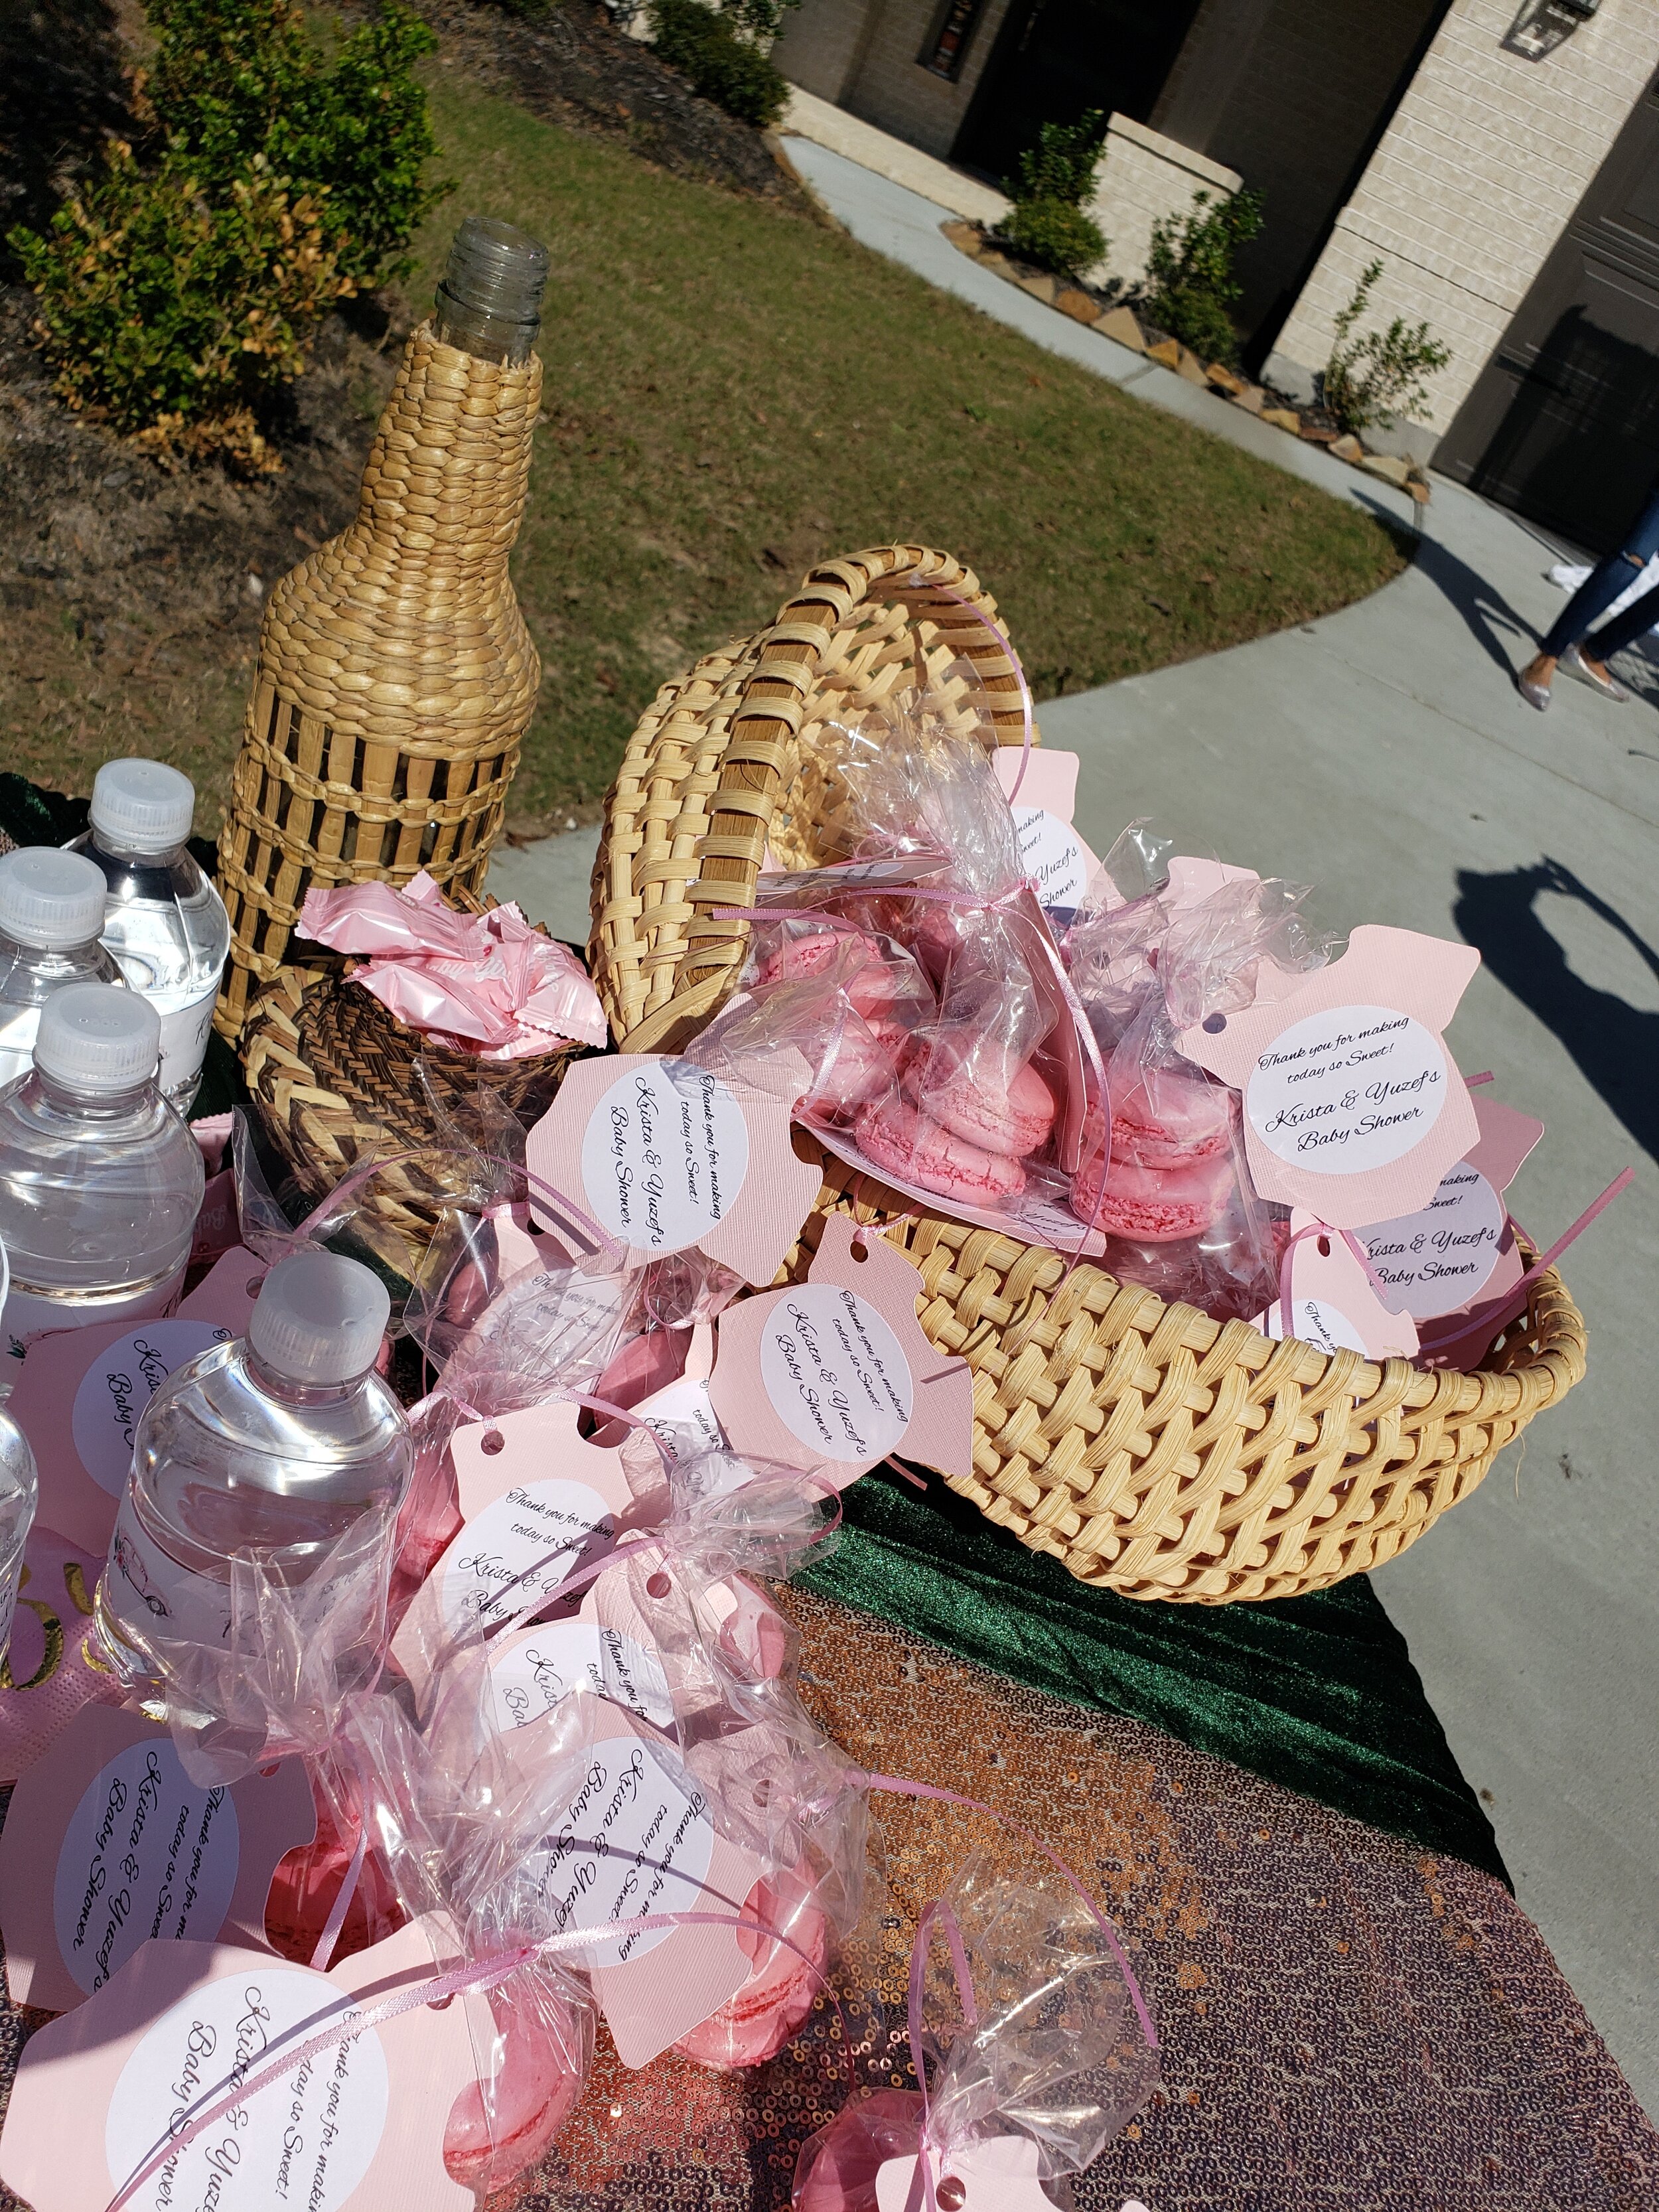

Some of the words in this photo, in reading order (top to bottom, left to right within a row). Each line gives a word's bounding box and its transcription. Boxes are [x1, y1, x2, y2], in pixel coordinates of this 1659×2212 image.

[1035, 846, 1078, 885] Yuzef's
[1039, 879, 1077, 909] Shower
[472, 957, 508, 982] Gir
[1258, 1048, 1307, 1070] Thank
[1309, 1042, 1333, 1057] you
[1332, 1034, 1356, 1051] for
[1358, 1017, 1409, 1039] making
[1287, 1067, 1325, 1083] today
[1329, 1061, 1342, 1071] so
[1346, 1043, 1394, 1066] Sweet!
[635, 1076, 659, 1147] Krista
[680, 1101, 693, 1138] today
[699, 1075, 715, 1122] Thank
[1265, 1103, 1336, 1132] Krista
[1340, 1090, 1359, 1109] &
[1365, 1070, 1441, 1105] Yuzef's
[611, 1106, 628, 1157] Baby
[684, 1140, 693, 1154] so
[702, 1124, 714, 1147] you
[1298, 1128, 1349, 1151] Baby
[1354, 1106, 1423, 1135] Shower
[642, 1149, 662, 1168] &
[684, 1157, 699, 1205] Sweet!
[704, 1145, 719, 1169] for
[615, 1161, 633, 1228] Shower
[642, 1174, 664, 1246] Yuzef's
[710, 1170, 721, 1219] making
[1410, 1234, 1430, 1253] &
[1431, 1228, 1497, 1253] Yuzef's
[1418, 1262, 1479, 1282] Shower
[1305, 1301, 1331, 1341] Thank
[1327, 1343, 1337, 1353] yo
[133, 1339, 169, 1396] Kris
[787, 1303, 822, 1366] Krista
[820, 1368, 835, 1386] &
[828, 1390, 867, 1456] Yuzef's
[832, 1318, 852, 1353] today
[850, 1355, 859, 1367] so
[857, 1368, 884, 1412] Sweet!
[839, 1291, 867, 1333] Thank
[861, 1333, 875, 1356] you
[871, 1356, 883, 1376] for
[882, 1378, 908, 1422] making
[107, 1373, 133, 1433] Baby
[776, 1334, 802, 1380] Baby
[799, 1384, 832, 1445] Shower
[692, 1409, 711, 1434] today
[506, 1488, 544, 1514] Thank
[545, 1509, 564, 1523] you
[563, 1513, 580, 1526] for
[580, 1520, 614, 1540] making
[510, 1522, 543, 1544] today
[543, 1534, 554, 1545] so
[555, 1536, 594, 1556] Sweet!
[459, 1553, 519, 1585] Krista
[522, 1572, 541, 1591] &
[526, 1649, 563, 1708] Kris
[601, 1629, 625, 1676] Thank
[618, 1674, 638, 1704] you
[96, 1777, 127, 1851] Baby
[129, 1751, 162, 1848] Krista
[569, 1761, 607, 1822] Baby
[603, 1749, 644, 1828] Krista
[169, 1805, 190, 1858] today
[198, 1786, 225, 1845] Thank
[642, 1804, 668, 1849] today
[674, 1791, 706, 1845] Thank
[119, 1853, 139, 1883] &
[190, 1846, 203, 1882] you
[590, 1832, 609, 1858] &
[634, 1850, 646, 1868] so
[660, 1844, 675, 1874] you
[165, 1862, 176, 1882] so
[182, 1878, 198, 1912] for
[554, 1861, 596, 1934] Yuzef
[648, 1868, 664, 1900] for
[72, 1855, 106, 1951] Shower
[149, 1885, 173, 1940] Swee
[171, 2020, 218, 2103] Baby
[290, 2040, 315, 2098] day
[332, 2011, 362, 2081] ank
[290, 2101, 304, 2123] so
[326, 2080, 340, 2118] you
[320, 2114, 338, 2152] for
[275, 2126, 303, 2200] Sweet!
[307, 2154, 328, 2212] maki
